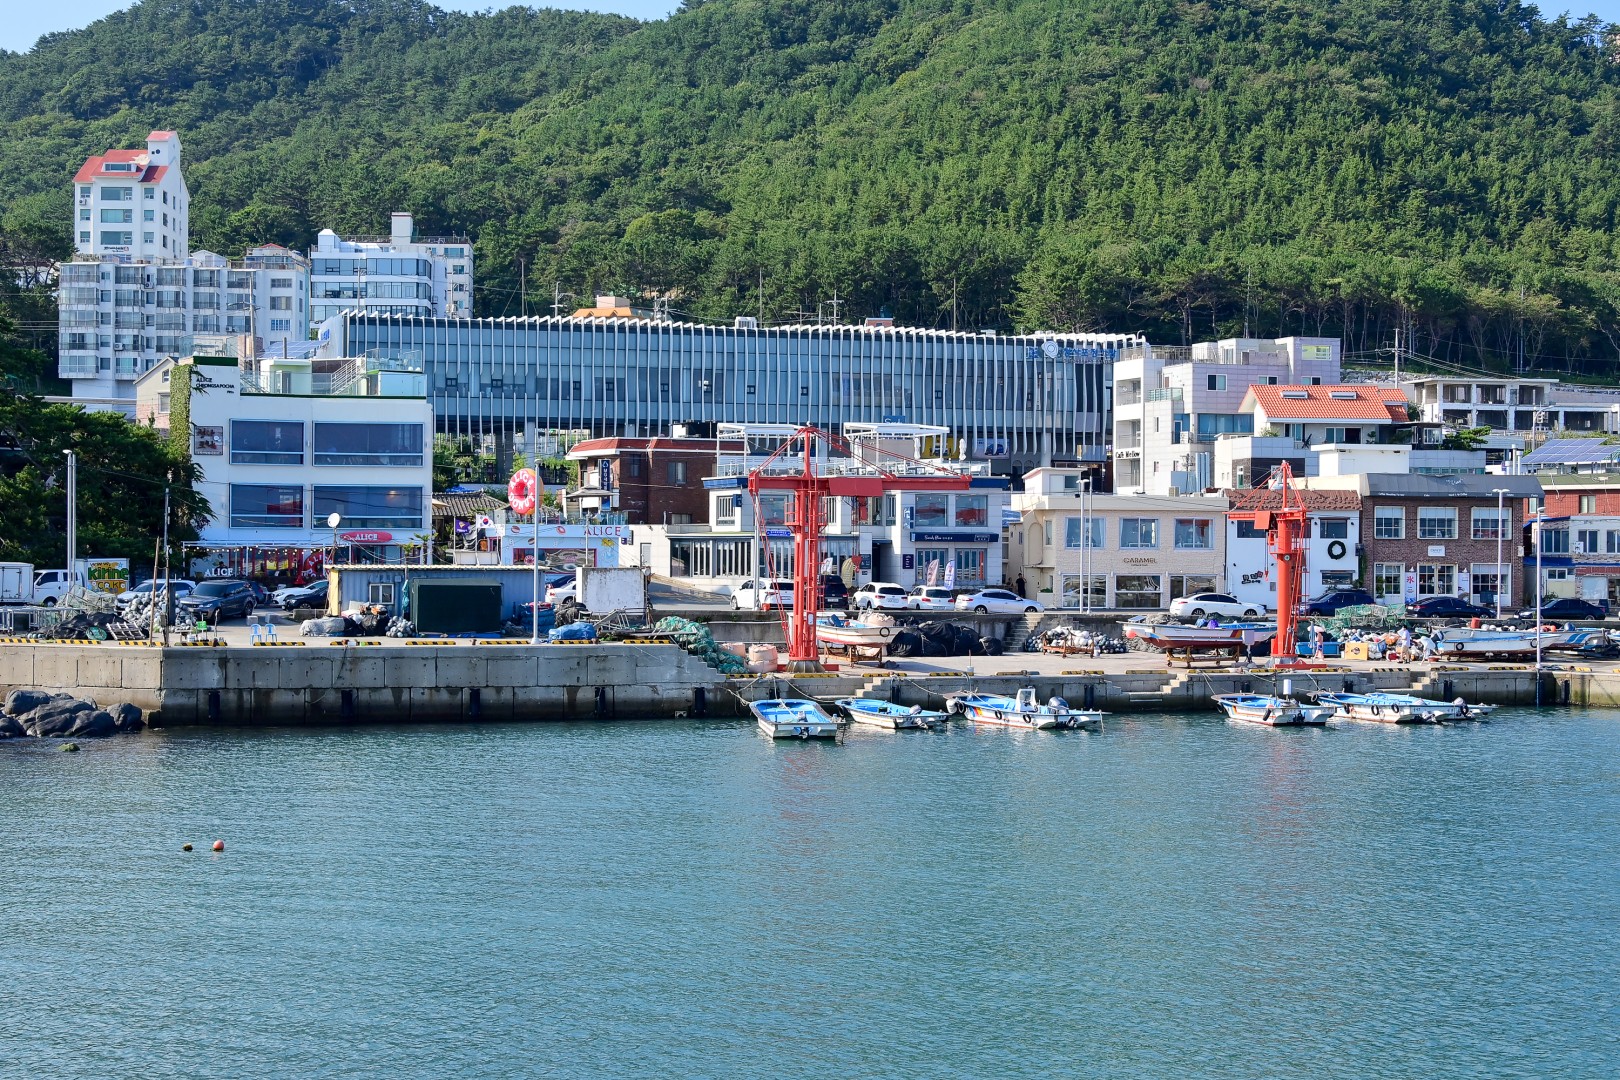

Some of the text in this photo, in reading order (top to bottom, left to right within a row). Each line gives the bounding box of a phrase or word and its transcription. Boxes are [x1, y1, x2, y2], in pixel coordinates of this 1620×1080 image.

[510, 471, 534, 490] ALICE
[508, 492, 535, 510] DONUT
[355, 533, 378, 541] ALICE
[584, 526, 621, 537] ALICE
[88, 566, 129, 581] kirine
[204, 567, 234, 578] ALICE
